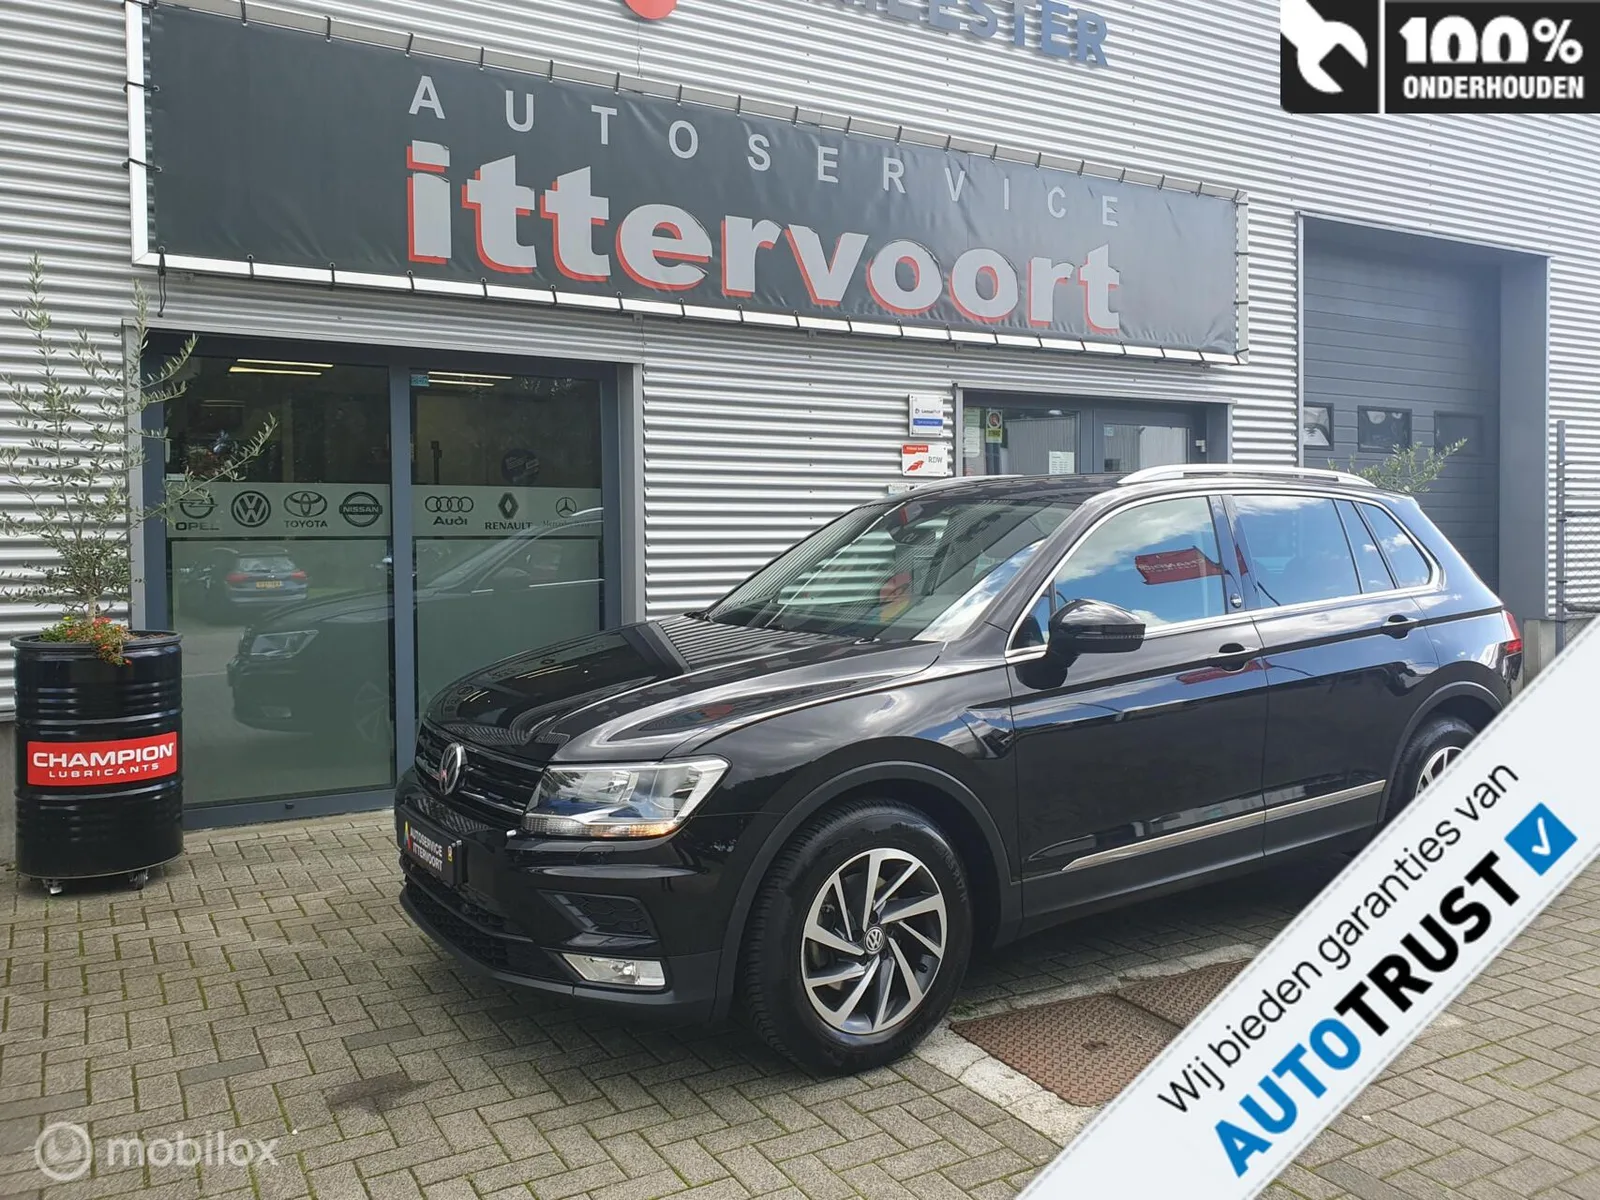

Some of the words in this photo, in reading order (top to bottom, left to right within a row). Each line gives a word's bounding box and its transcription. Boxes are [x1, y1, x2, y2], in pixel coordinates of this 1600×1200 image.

[406, 140, 1120, 333] ittervoort
[342, 505, 380, 513] NISSAN
[284, 520, 328, 528] TOYOTA
[433, 515, 468, 526] Audi
[175, 521, 220, 531] OPEL
[484, 521, 533, 531] RENAULT
[32, 742, 175, 768] CHAMPION
[48, 762, 160, 778] LUBRICANTS
